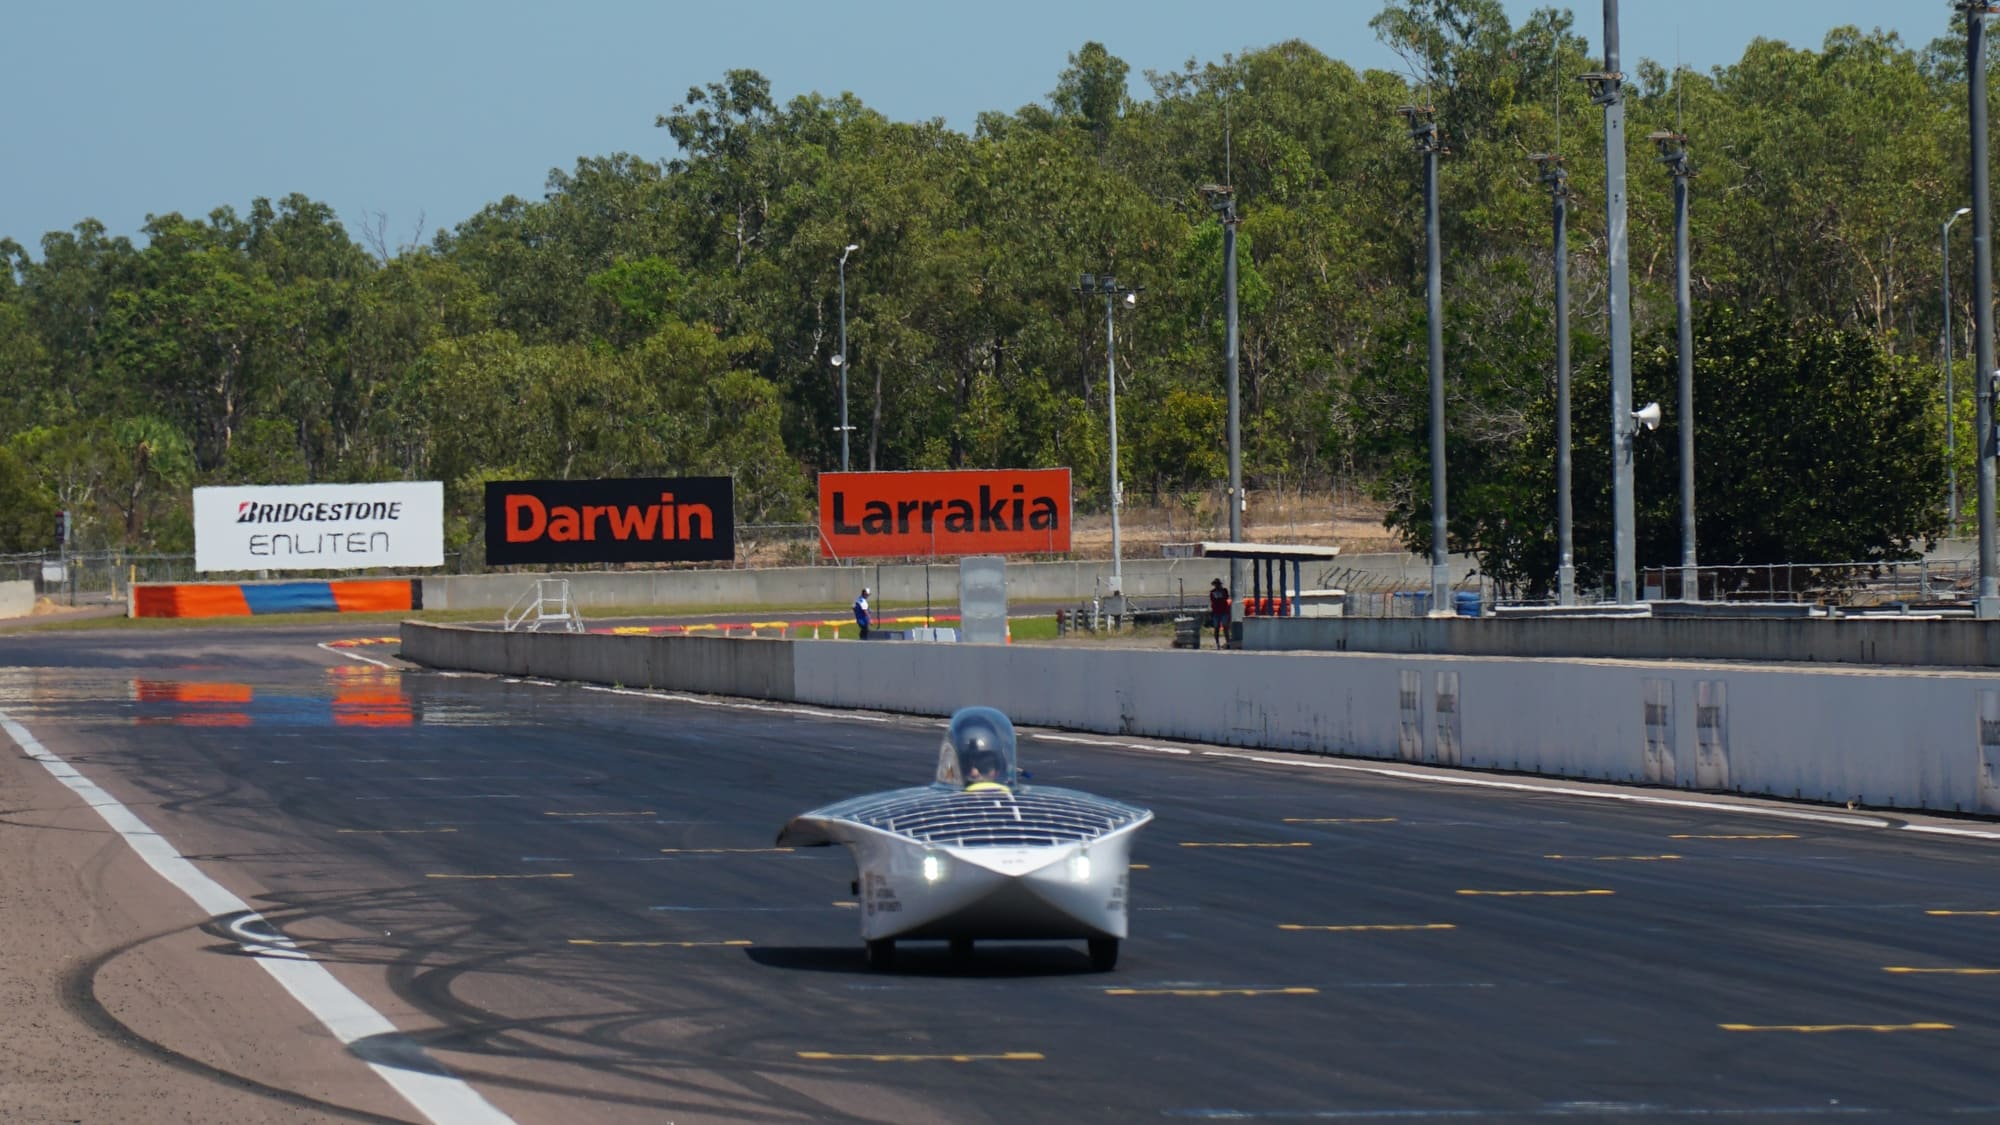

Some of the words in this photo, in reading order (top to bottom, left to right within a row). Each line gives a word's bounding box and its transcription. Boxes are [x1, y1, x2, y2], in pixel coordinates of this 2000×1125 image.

[237, 500, 402, 522] BRIDGESTONE
[506, 493, 714, 543] Darwin
[832, 484, 1058, 535] Larrakia
[249, 531, 389, 555] ENLITEN
